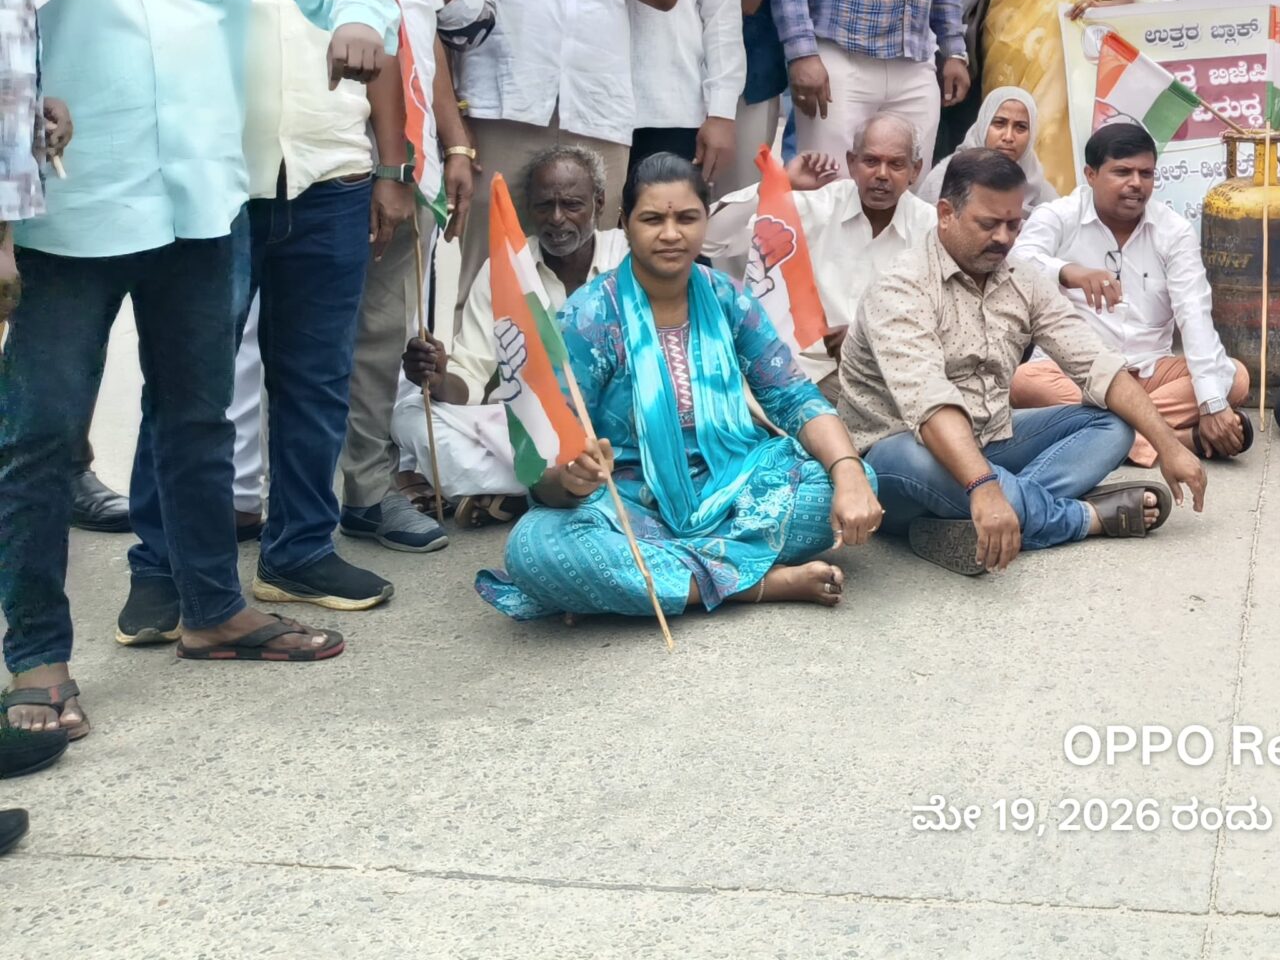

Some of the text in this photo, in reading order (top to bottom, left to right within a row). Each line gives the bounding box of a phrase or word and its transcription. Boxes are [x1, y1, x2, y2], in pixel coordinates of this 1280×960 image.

[1144, 23, 1200, 48] ಉತ್ತರ
[1211, 18, 1260, 44] ಬ್ಲಾಕ್
[1208, 60, 1268, 86] ಬಿಜೆಪಿ
